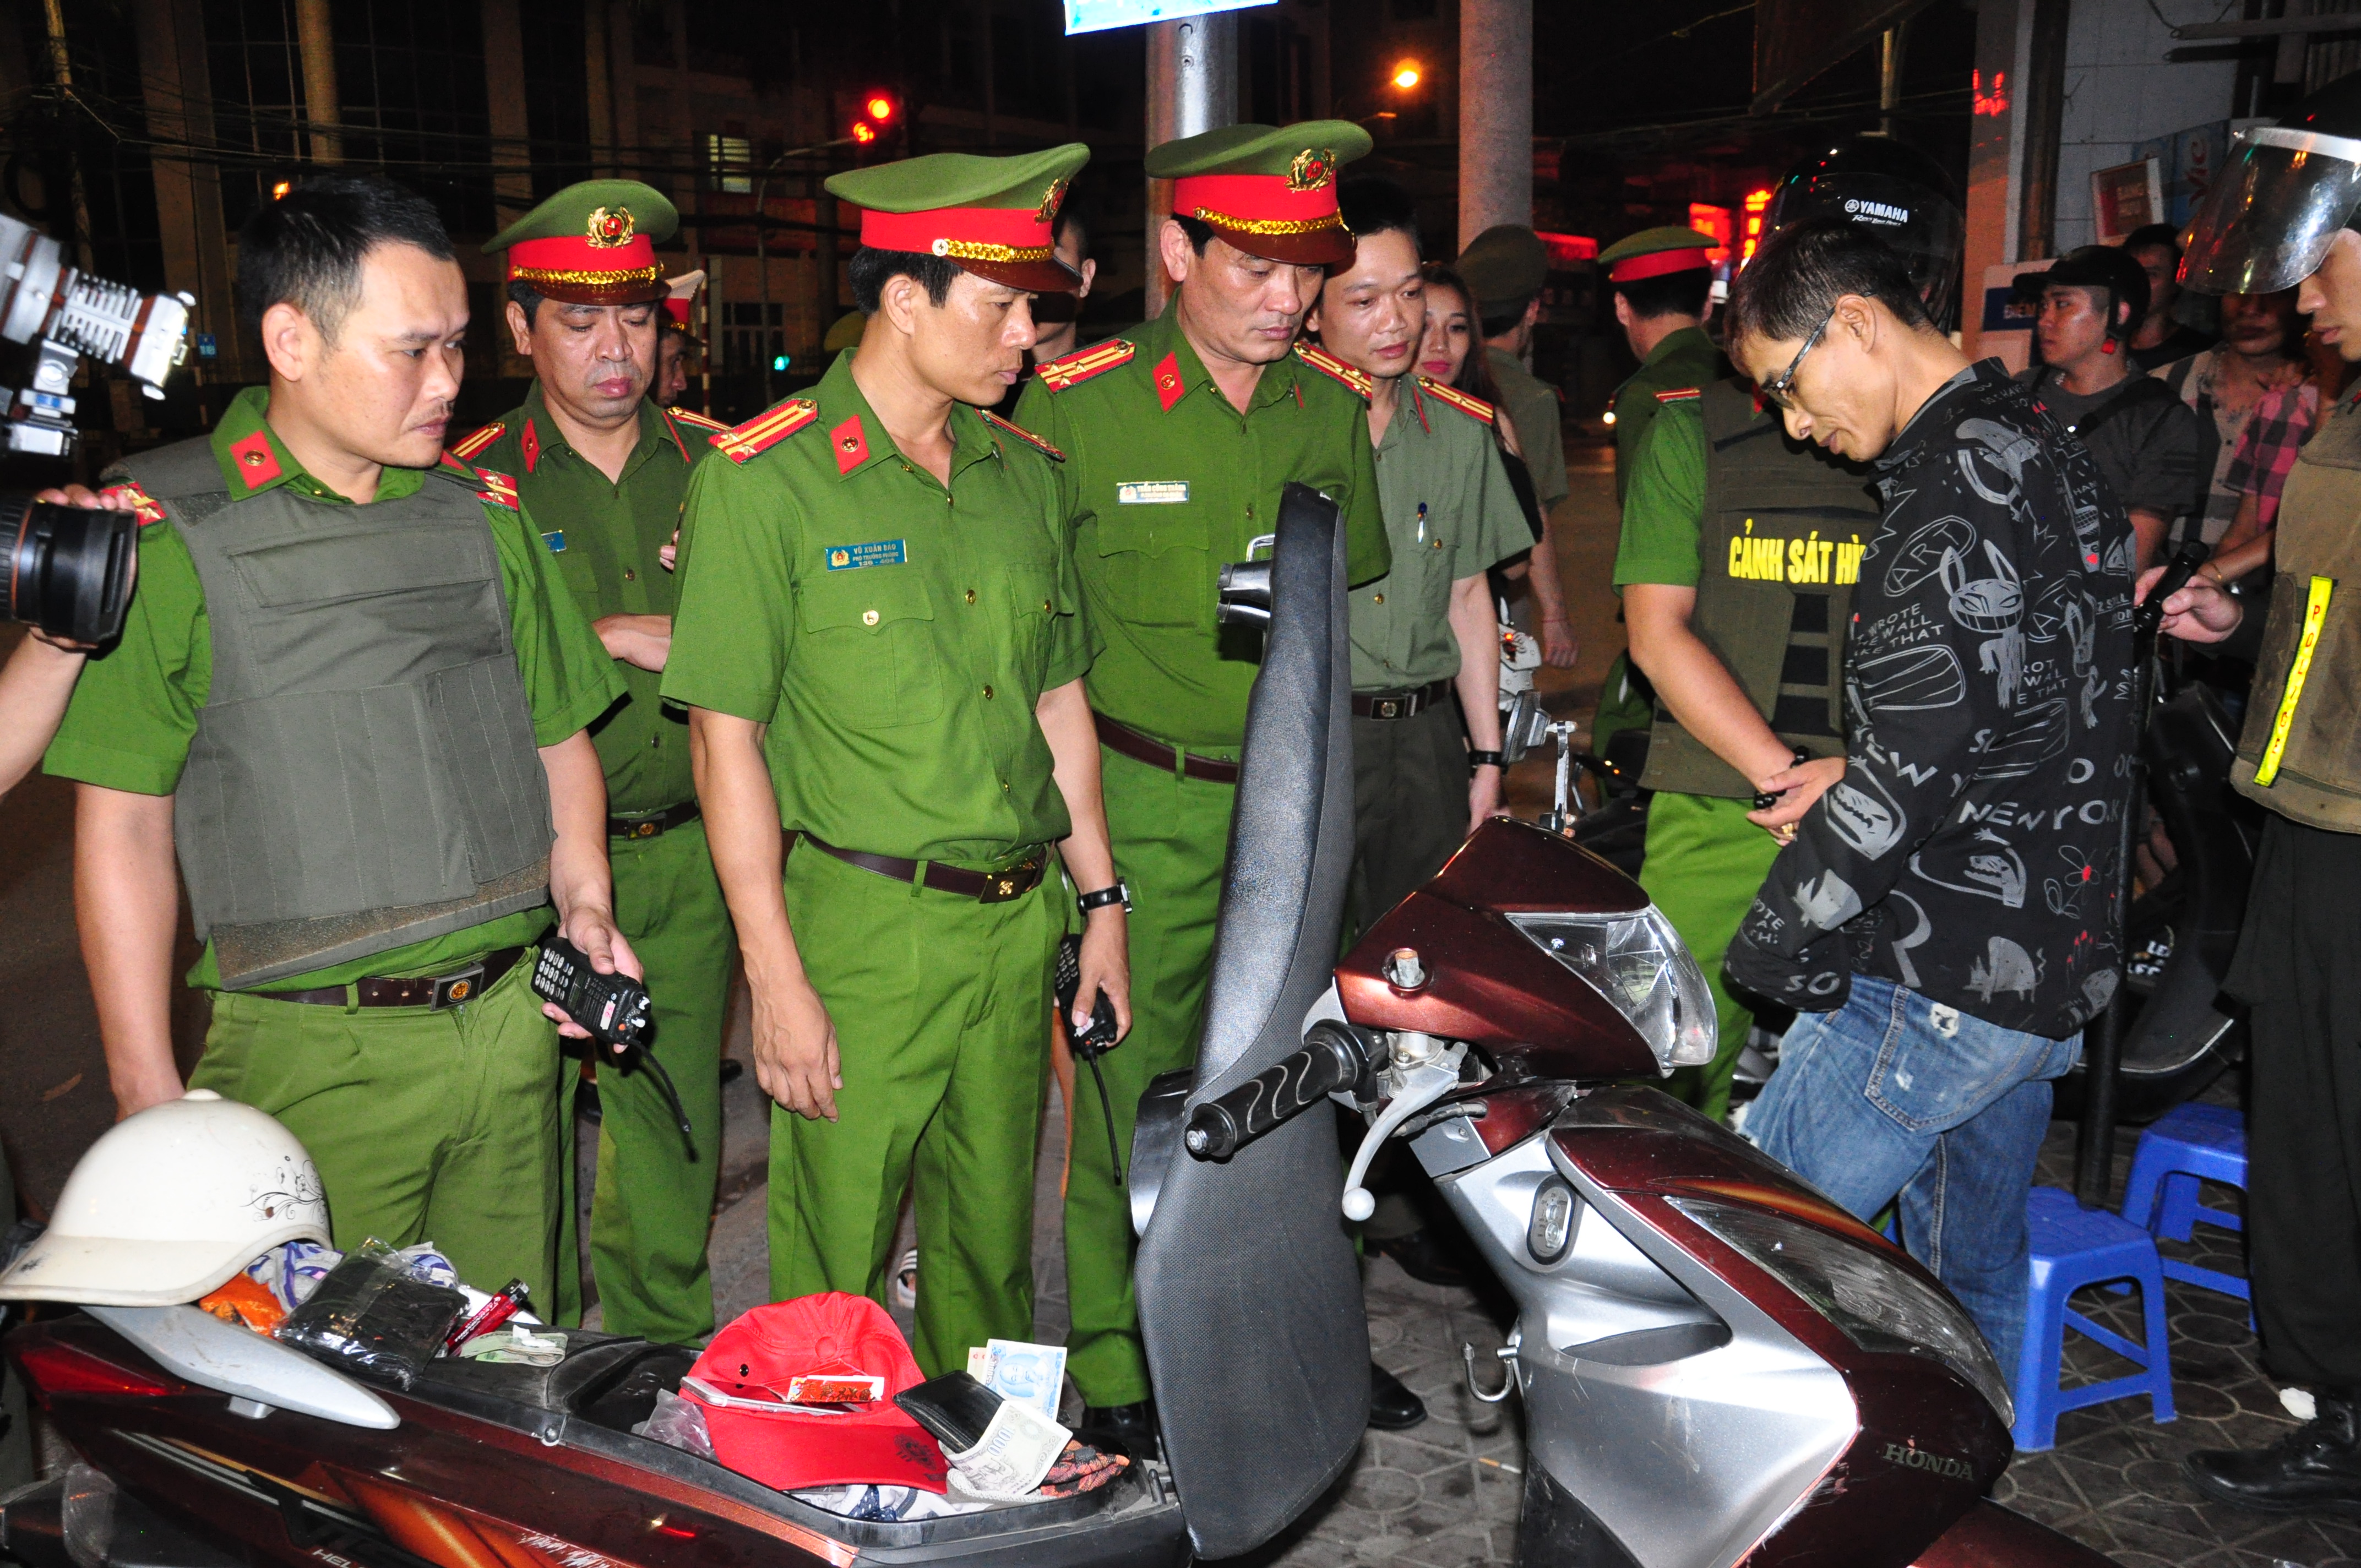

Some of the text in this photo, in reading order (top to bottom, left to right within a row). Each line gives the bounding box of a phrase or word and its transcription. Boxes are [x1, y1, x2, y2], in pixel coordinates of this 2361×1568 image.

[1860, 200, 1908, 224] YAMAHA
[864, 544, 882, 553] XUÂN
[1728, 518, 1867, 585] CẢNH SÁT HÌ
[1868, 602, 1921, 636] WROTE
[1883, 614, 1932, 639] WALL
[1889, 624, 1945, 647] THAT
[987, 1424, 1016, 1456] 1000
[1883, 1442, 1974, 1482] HONDA
[312, 1548, 366, 1568] HEL
